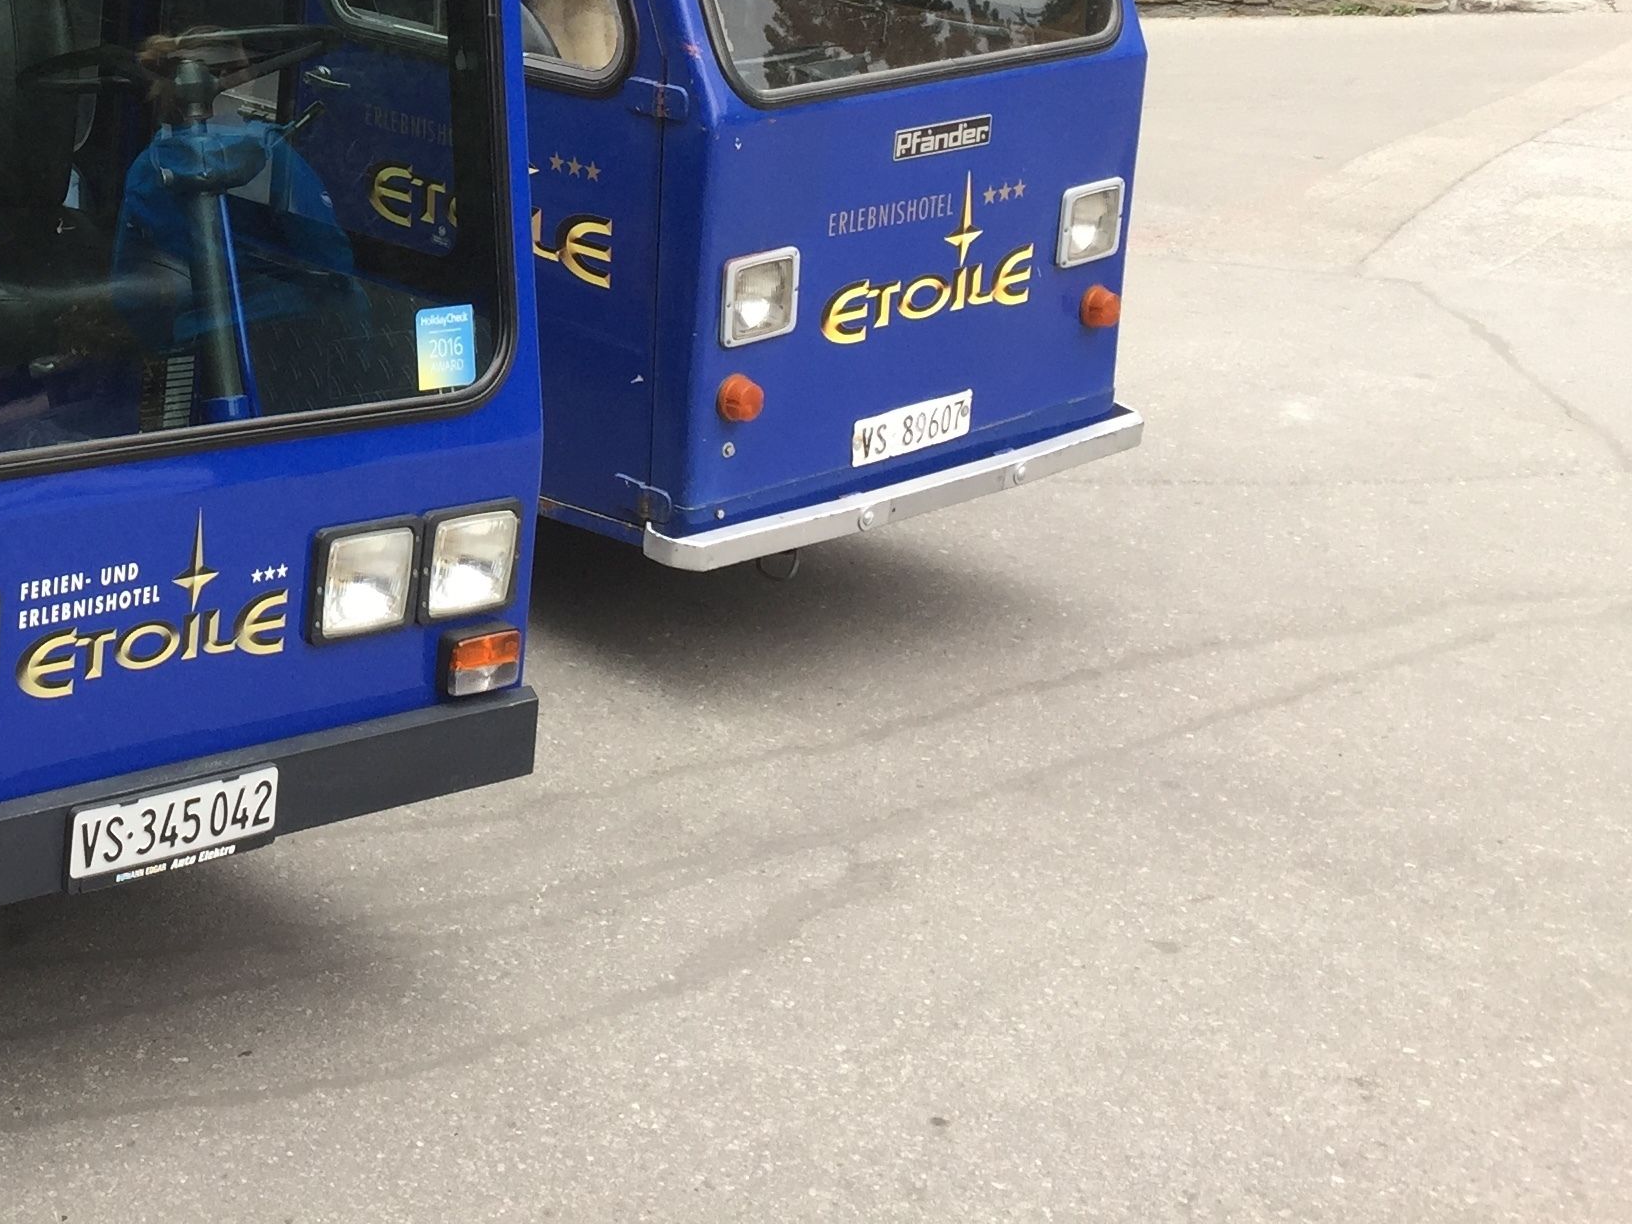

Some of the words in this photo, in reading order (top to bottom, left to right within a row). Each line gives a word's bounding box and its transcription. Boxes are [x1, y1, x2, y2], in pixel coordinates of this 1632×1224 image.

[828, 192, 954, 237] ERLEBNISHOTEL
[820, 242, 1035, 345] ETOILE
[429, 336, 464, 359] 2016
[20, 572, 92, 602] FERIEN-
[100, 562, 140, 586] UND
[18, 584, 161, 630] ERLEBNISHOTEL
[16, 588, 290, 699] ETOILE
[170, 855, 197, 870] Auto
[198, 844, 236, 863] Elektro
